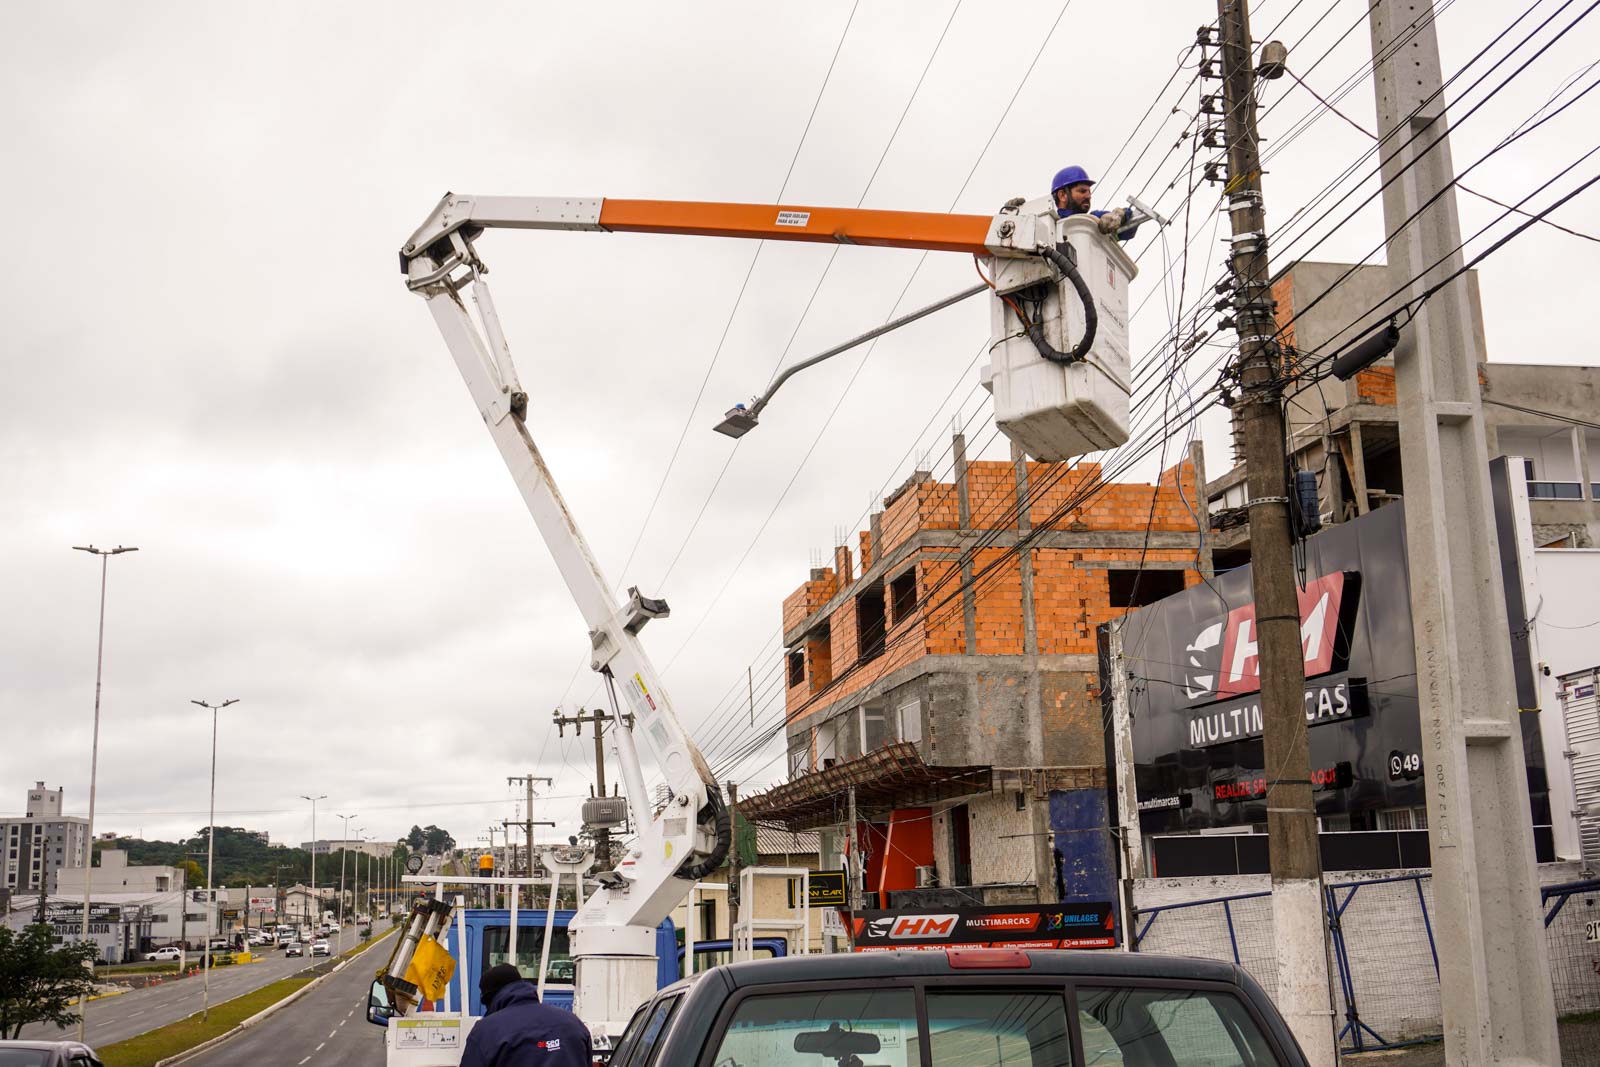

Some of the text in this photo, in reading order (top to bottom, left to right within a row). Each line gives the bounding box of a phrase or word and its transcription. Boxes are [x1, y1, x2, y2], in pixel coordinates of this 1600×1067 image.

[1403, 754, 1420, 771] 49
[1215, 780, 1251, 799] REALIZE
[894, 918, 954, 936] HM
[966, 917, 1031, 927] MULTIMARCAS
[1064, 914, 1099, 923] UNILAGES
